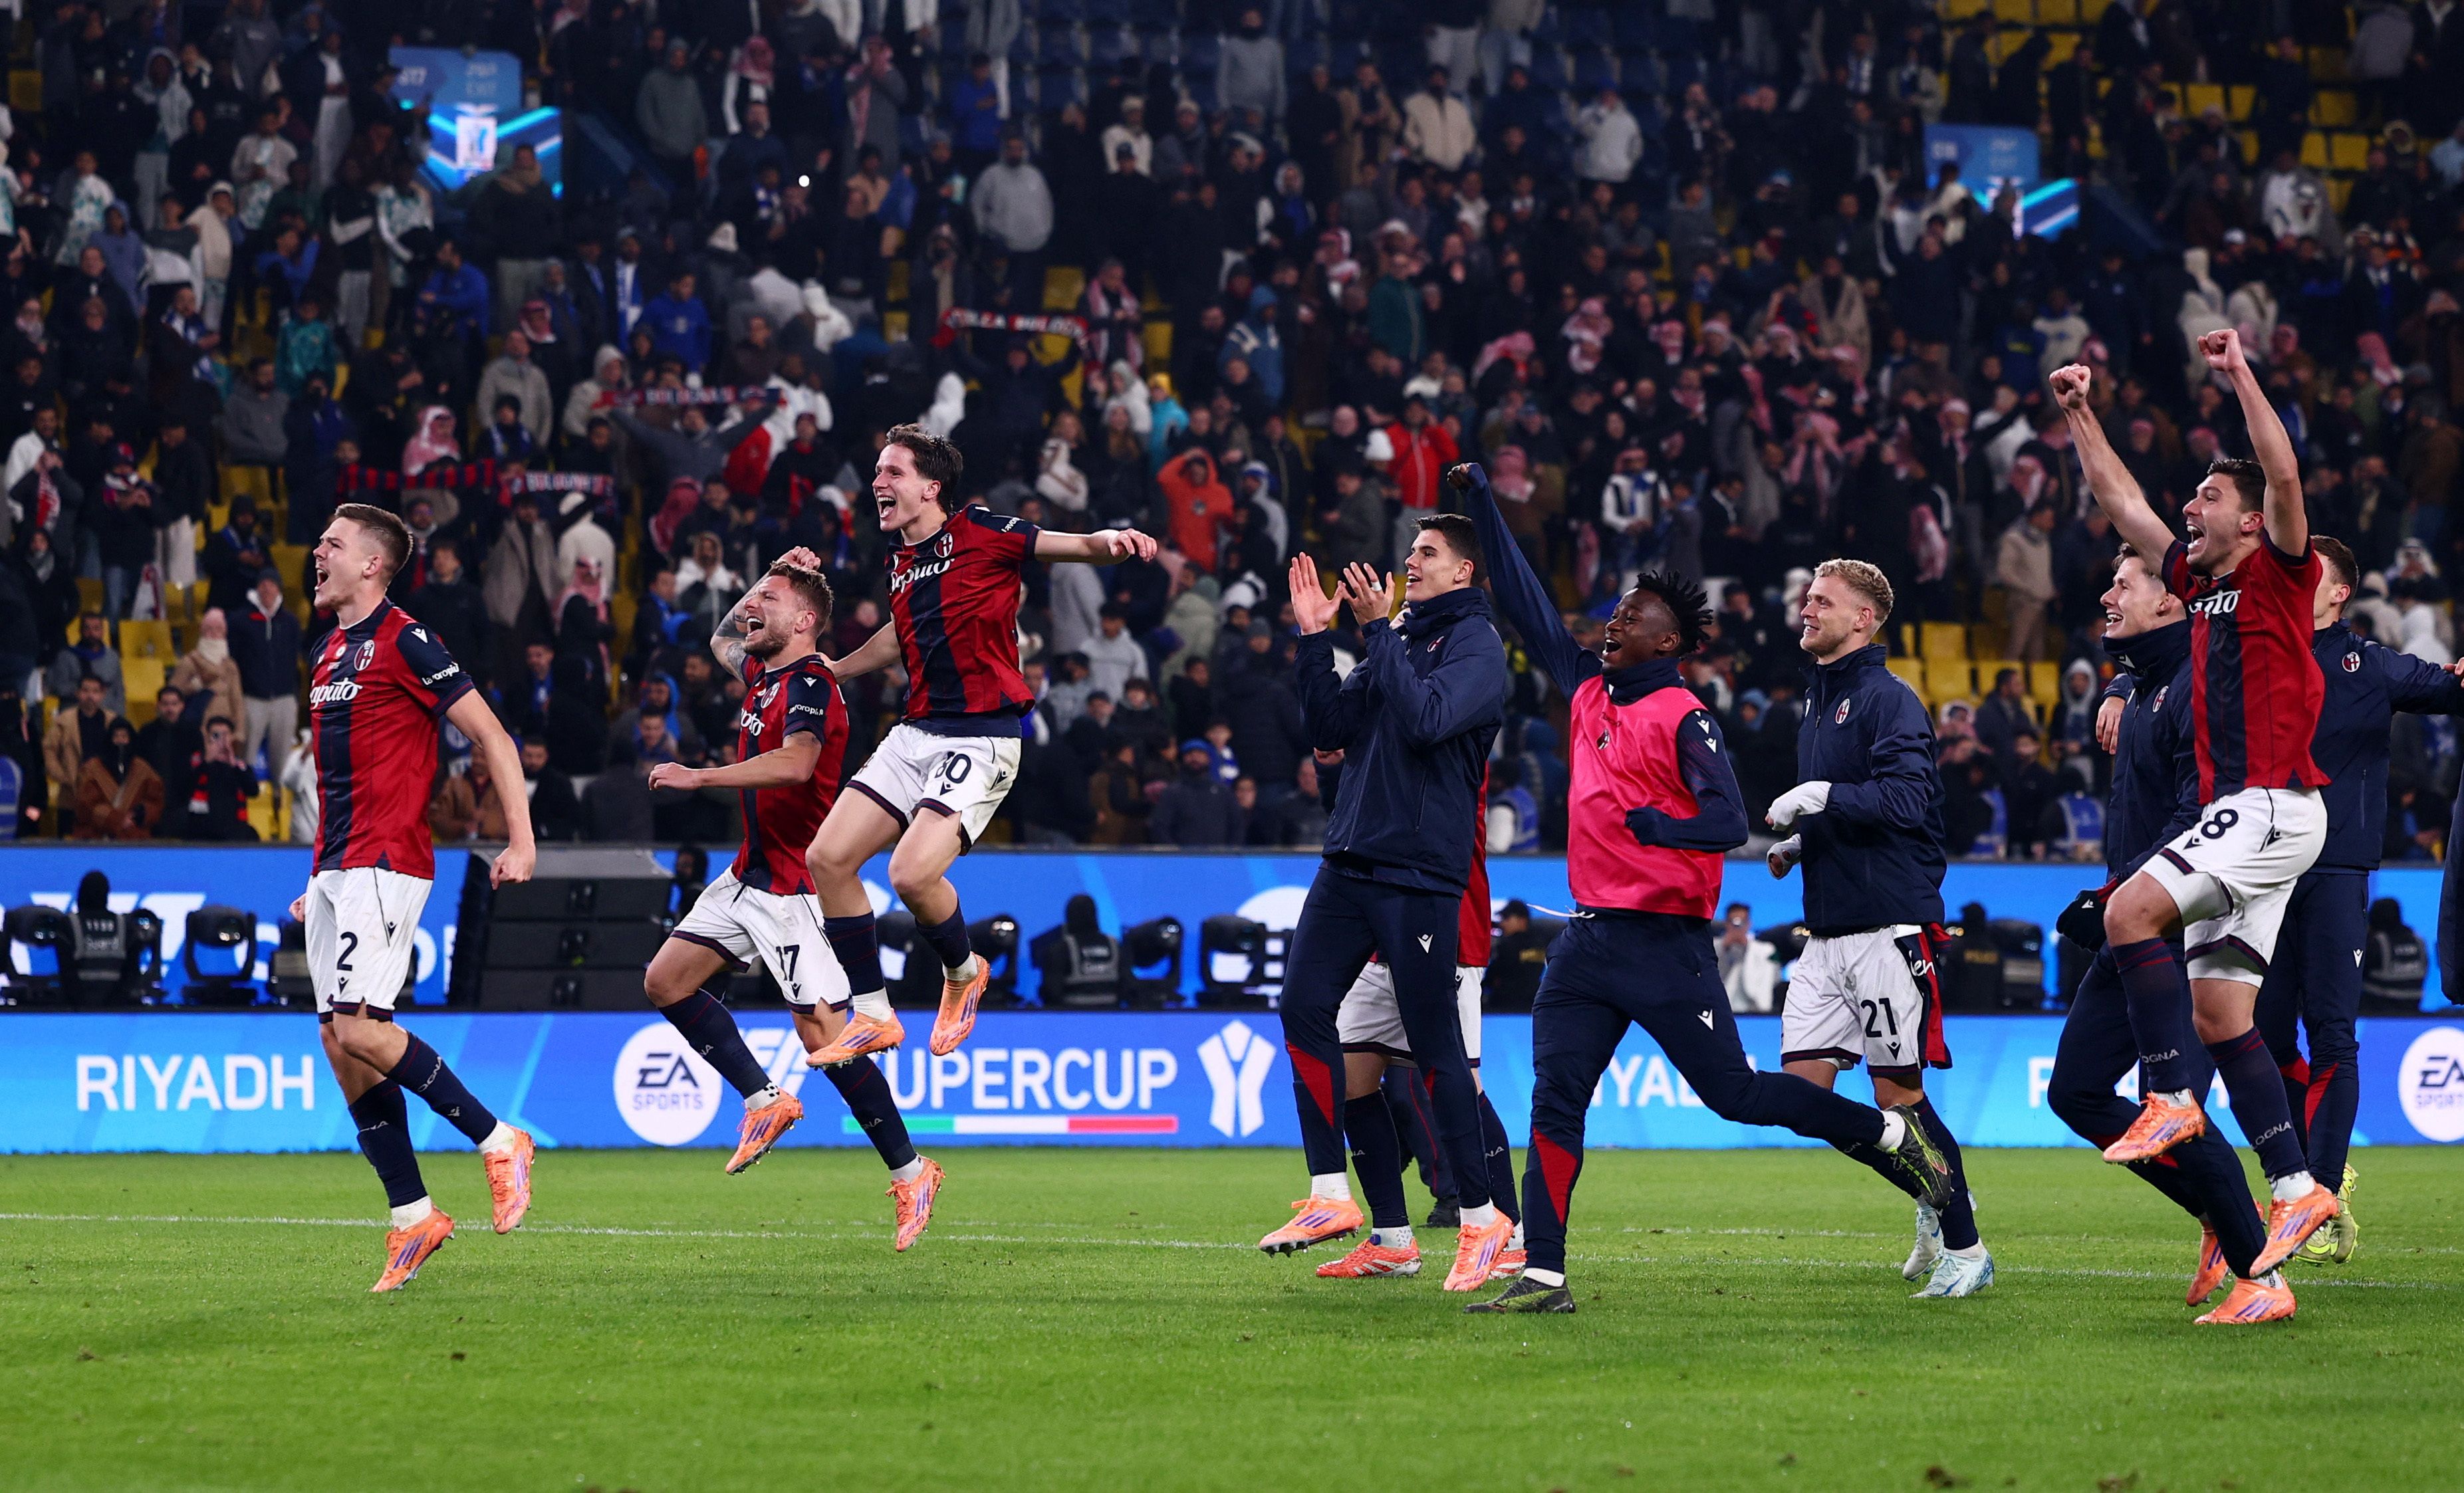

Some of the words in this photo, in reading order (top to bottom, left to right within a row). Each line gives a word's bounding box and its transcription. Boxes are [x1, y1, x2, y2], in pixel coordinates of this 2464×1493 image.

[309, 677, 363, 709] aputo
[2201, 808, 2239, 840] 8
[336, 931, 358, 971] 2
[776, 944, 800, 982] 17
[1860, 997, 1898, 1038] 21
[76, 1054, 314, 1112] RIYADH
[637, 1053, 699, 1088] EA
[844, 1048, 1178, 1110] UPERCUP
[632, 1093, 704, 1110] SPORTS
